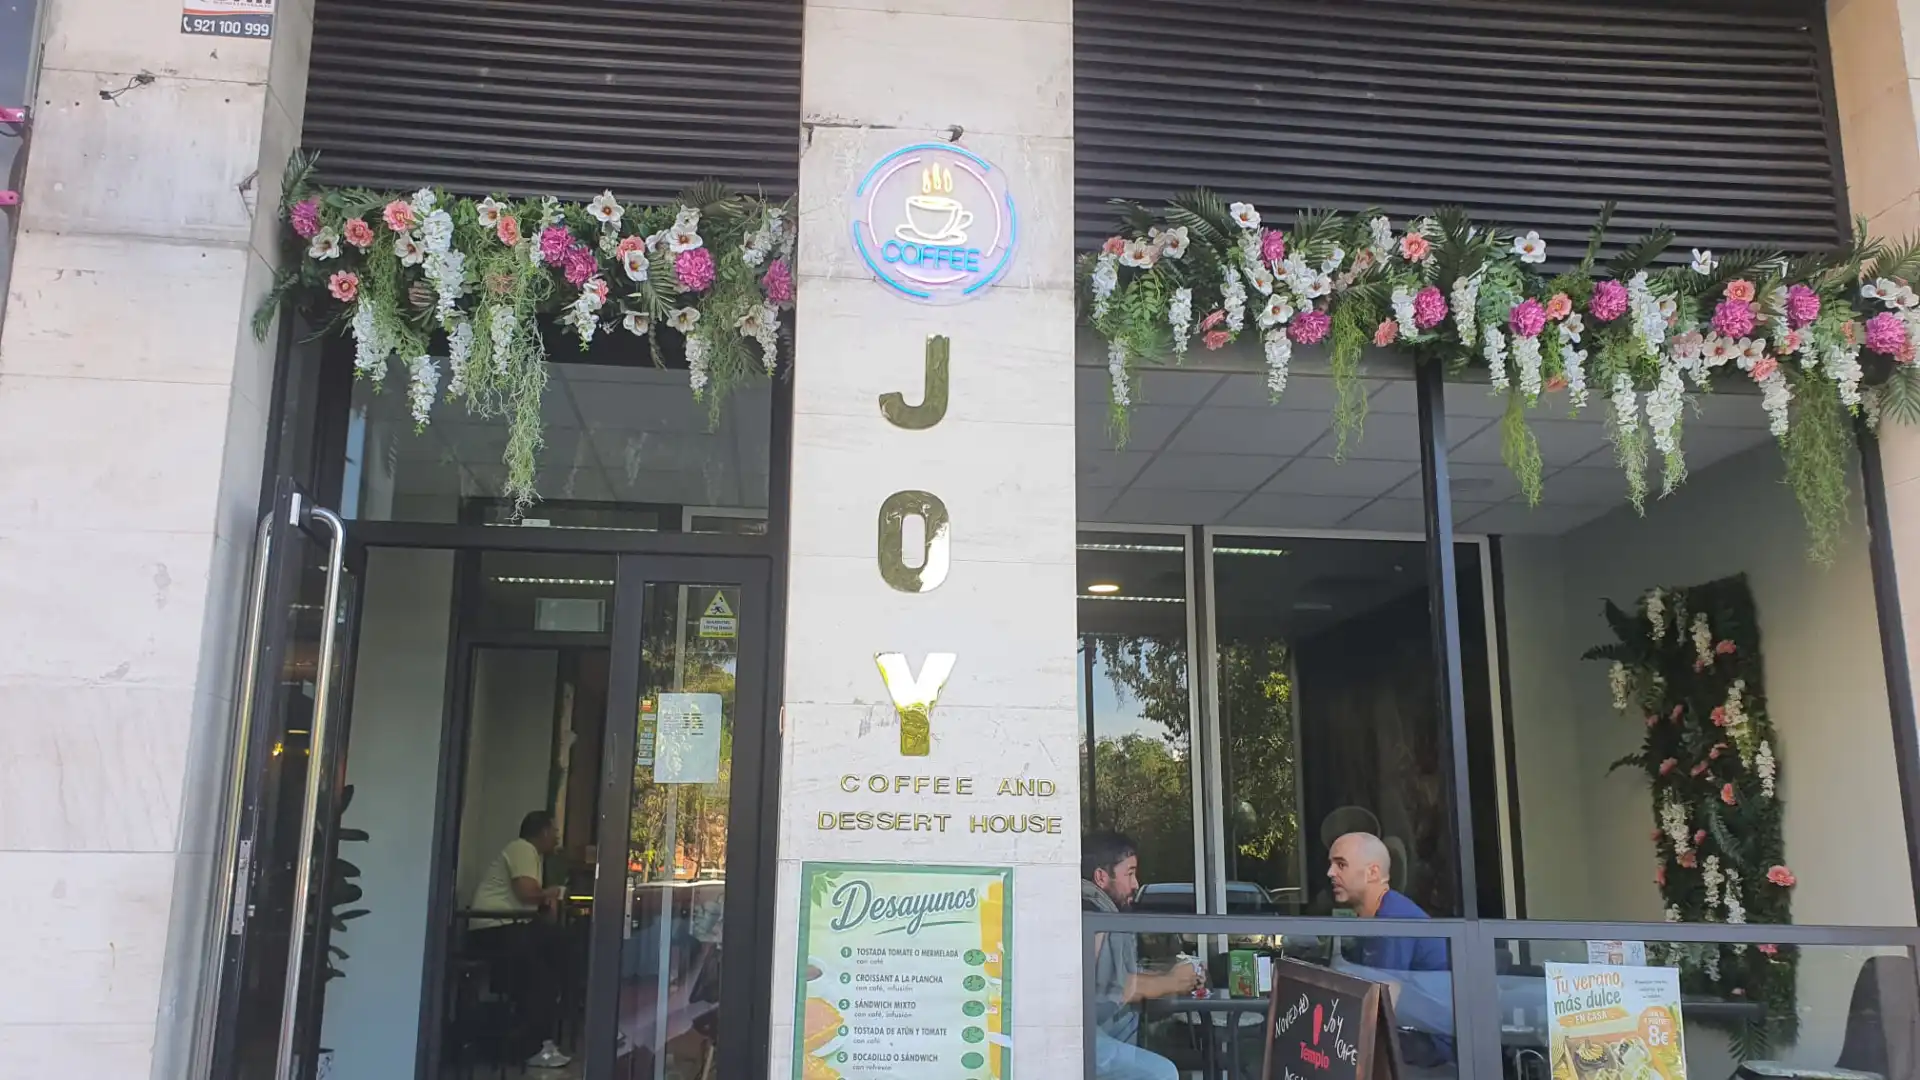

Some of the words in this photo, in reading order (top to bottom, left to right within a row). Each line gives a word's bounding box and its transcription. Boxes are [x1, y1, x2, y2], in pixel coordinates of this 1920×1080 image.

[194, 19, 216, 32] 921
[219, 21, 241, 34] 100
[244, 23, 269, 36] 999
[882, 239, 981, 273] COFFEE
[840, 774, 974, 795] COFFEE
[997, 777, 1056, 796] AND
[817, 810, 952, 832] DESSERT
[970, 813, 1062, 834] HOUSE
[830, 880, 976, 935] Desayunos
[856, 948, 886, 956] TOSTADA
[888, 948, 913, 957] TOMATE
[914, 949, 920, 957] O
[921, 949, 959, 958] MERMELADA
[855, 974, 894, 983] CROISSANT
[894, 975, 900, 983] A
[901, 975, 910, 983] LA
[911, 975, 943, 983] PLANCHA
[1553, 975, 1568, 996] Tu
[1573, 972, 1624, 991] verano,
[854, 998, 892, 1009] SÁNDWICH
[894, 1000, 916, 1009] MIXTO
[1554, 993, 1582, 1015] más
[1586, 988, 1621, 1009] dulce
[1274, 993, 1309, 1039] NOVEDAD
[853, 1027, 885, 1035] TOSTADA
[886, 1027, 895, 1035] DE
[896, 1026, 914, 1036] ATÚN
[915, 1028, 920, 1036] Y
[921, 1028, 947, 1036] TOMATE
[1648, 1025, 1669, 1046] 8€
[852, 1053, 891, 1061] BOCADILLO
[893, 1053, 899, 1062] O
[901, 1052, 938, 1062] SÁNDWICH
[1300, 1041, 1330, 1071] Templo
